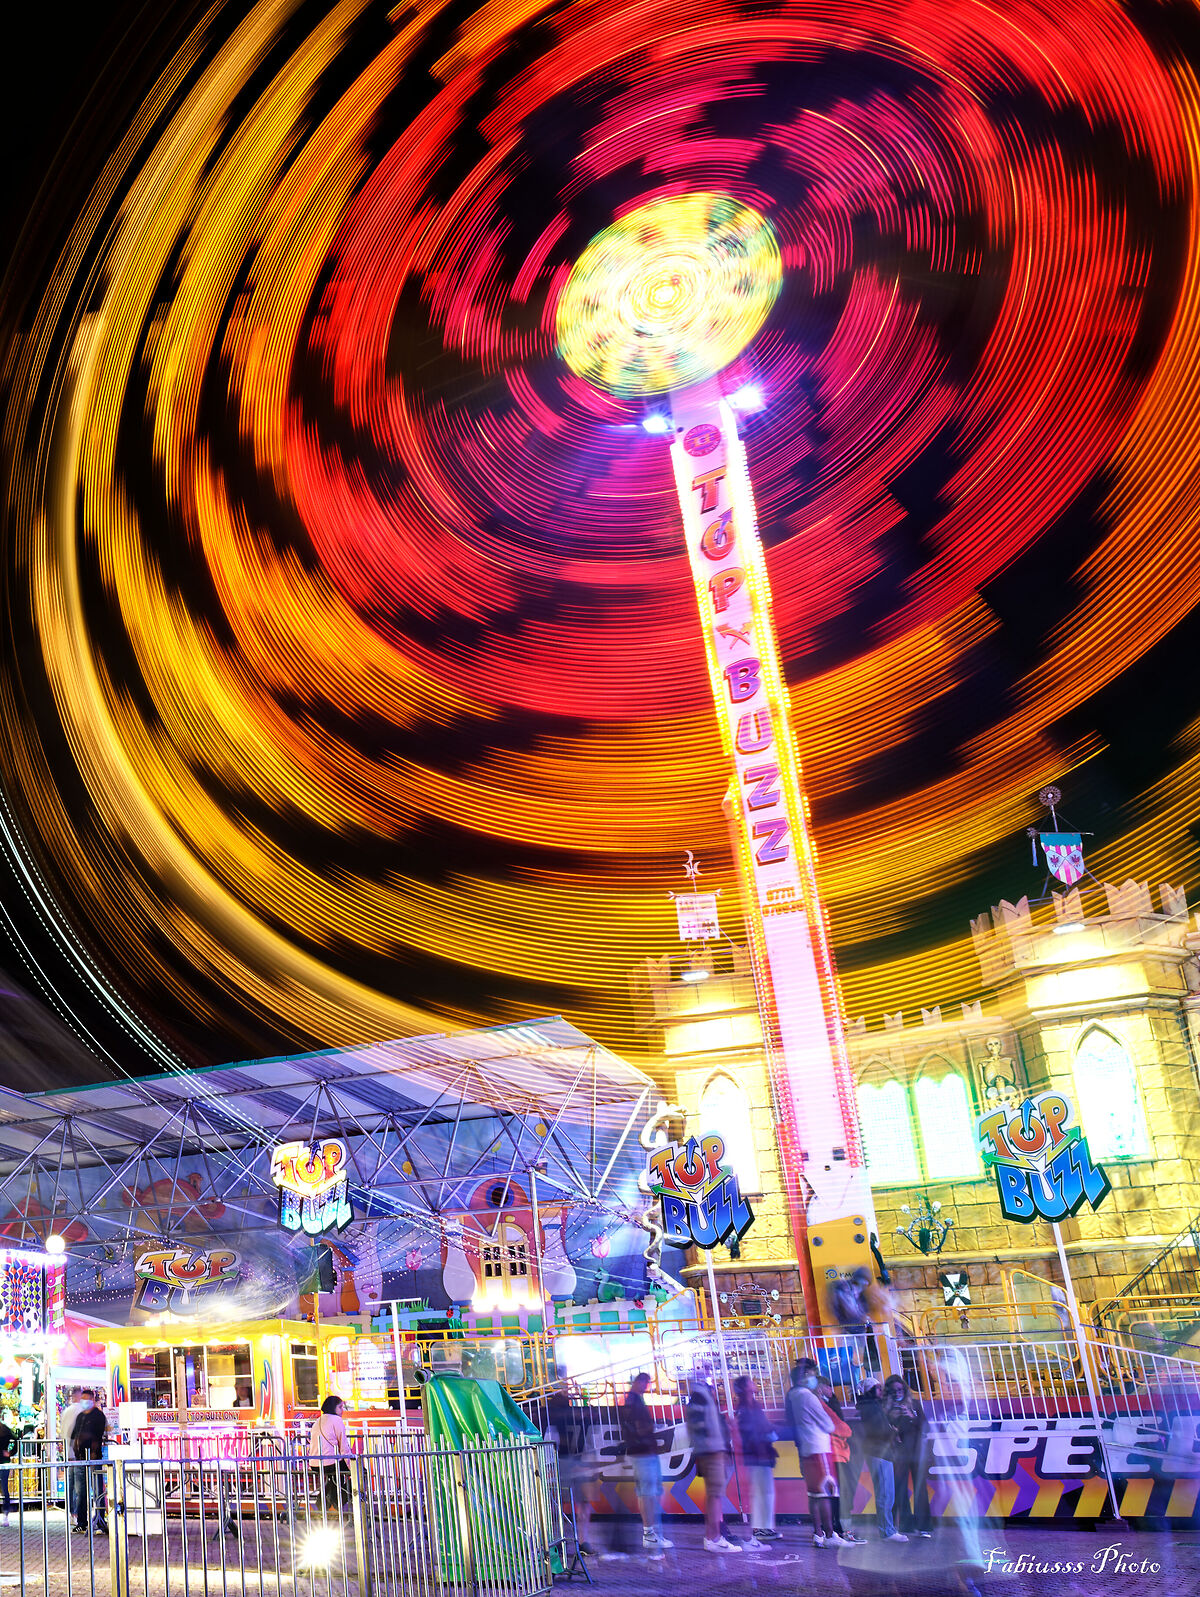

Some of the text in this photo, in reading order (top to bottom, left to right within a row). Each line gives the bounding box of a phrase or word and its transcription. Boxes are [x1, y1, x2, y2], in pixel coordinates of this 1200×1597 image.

[692, 465, 746, 614] TOP
[724, 657, 791, 866] BUZZ
[979, 1096, 1068, 1160] TOP
[275, 1143, 343, 1187] TOP
[650, 1136, 725, 1191] TOP
[995, 1137, 1112, 1224] BUZZ
[278, 1178, 355, 1238] BUZZ
[660, 1174, 755, 1250] BUZZ
[141, 1252, 237, 1280] TOP
[149, 1411, 175, 1422] TOKENS
[191, 1411, 205, 1421] TOP
[206, 1411, 223, 1420] BUZZ
[223, 1410, 240, 1420] ONLY
